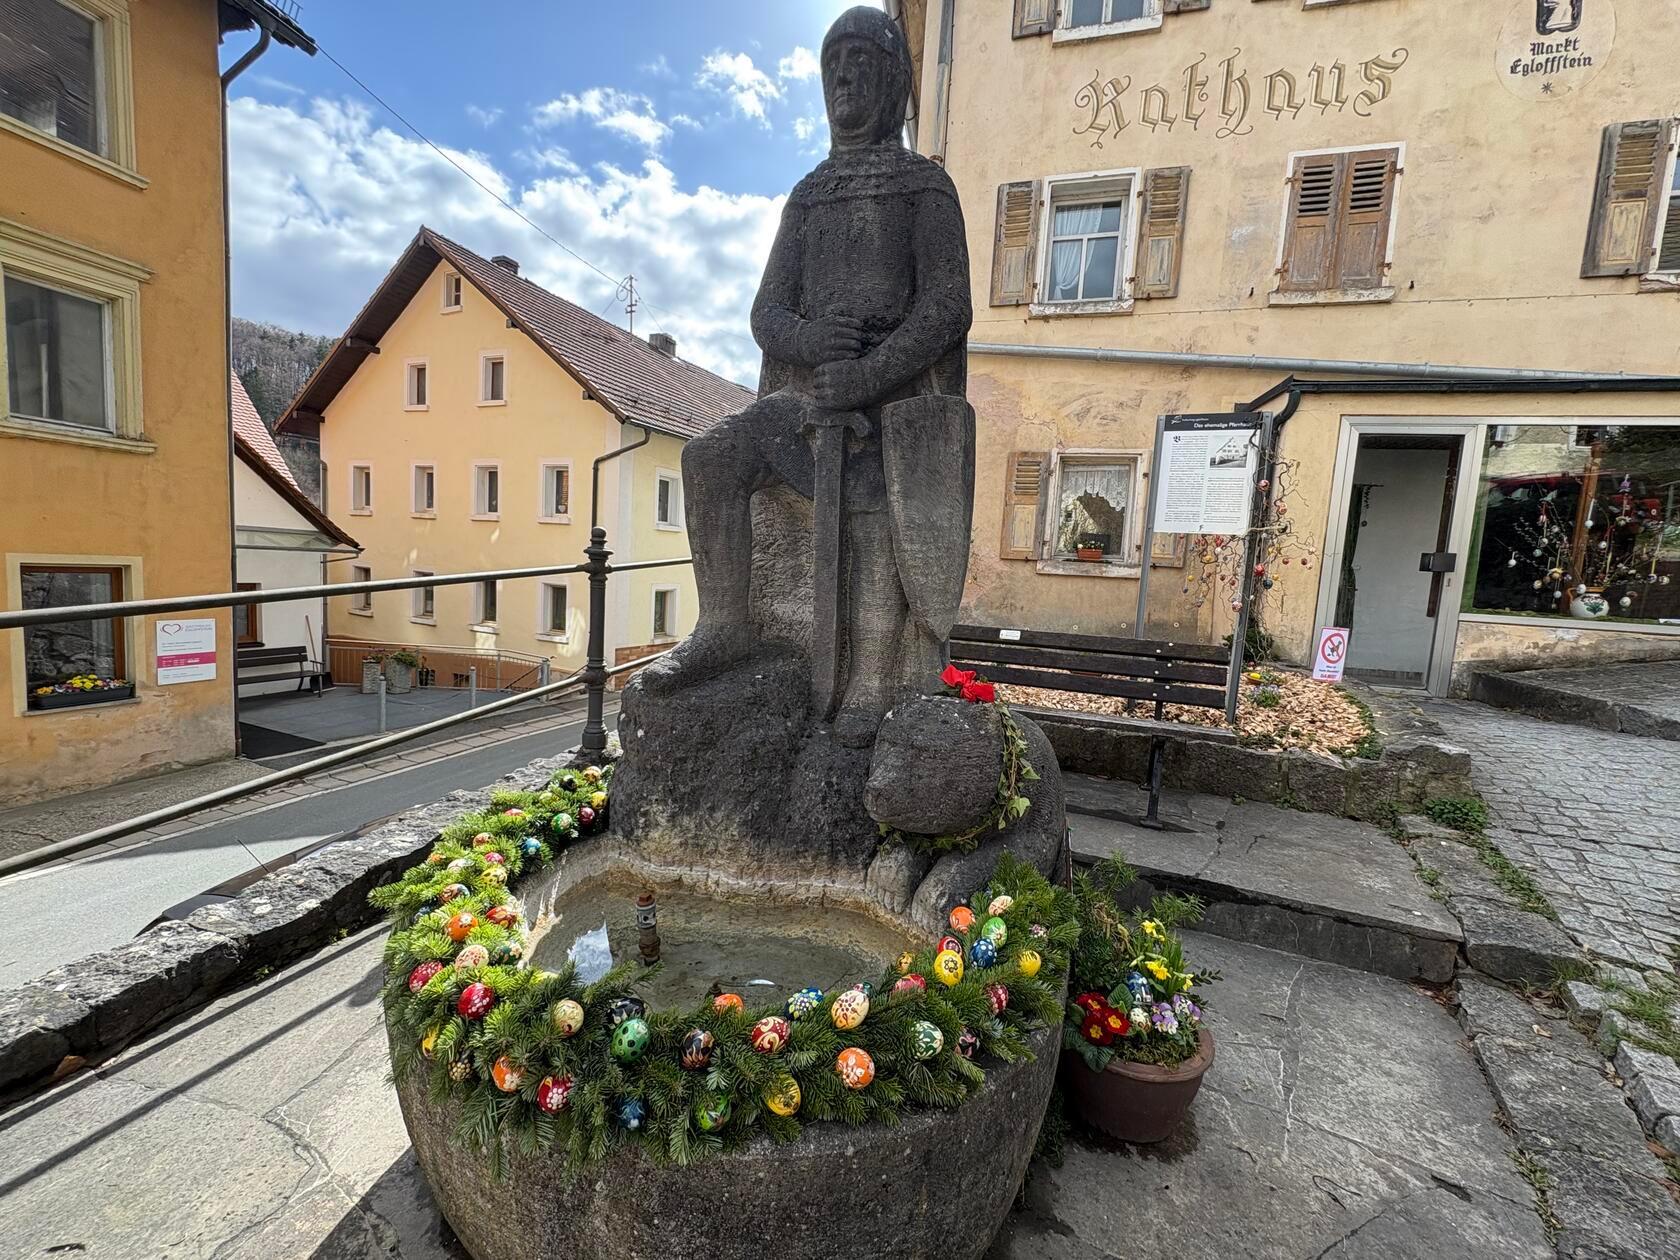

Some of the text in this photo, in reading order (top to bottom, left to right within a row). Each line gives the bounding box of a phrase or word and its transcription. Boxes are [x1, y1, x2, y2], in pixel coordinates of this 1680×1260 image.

[1530, 36, 1580, 56] Markt
[1510, 52, 1593, 77] Egloffstein
[1072, 47, 1409, 149] Rathaus
